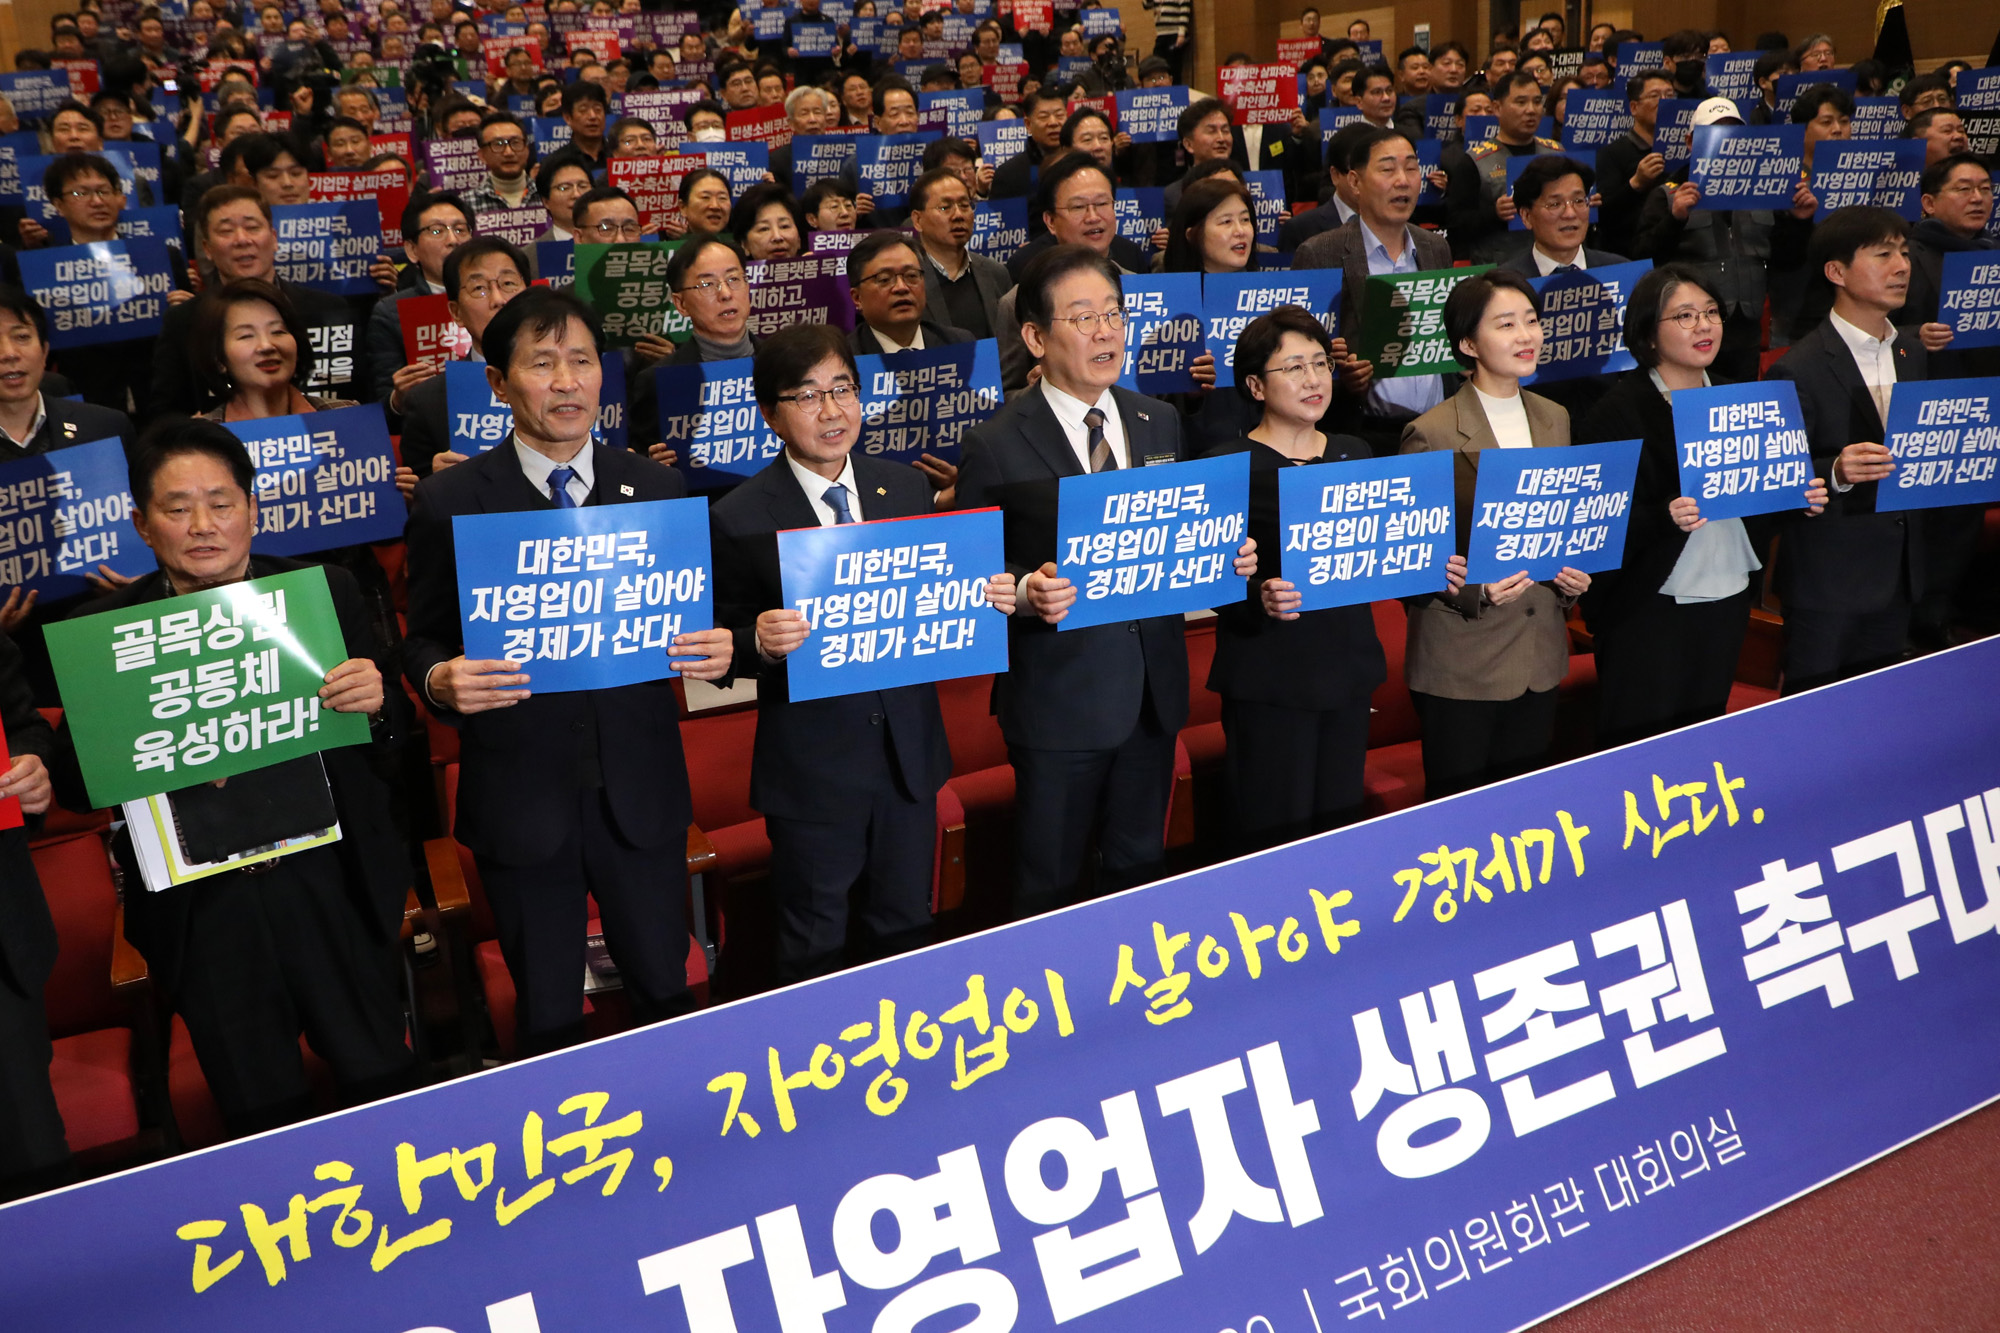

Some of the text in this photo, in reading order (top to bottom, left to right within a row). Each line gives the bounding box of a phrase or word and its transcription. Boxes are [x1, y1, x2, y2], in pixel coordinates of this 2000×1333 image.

[1220, 67, 1260, 80] 대기업만
[1120, 108, 1157, 121] 자영업이
[1132, 94, 1173, 107] 대한민국,
[1236, 96, 1279, 108] 할인행사
[1584, 99, 1625, 114] 대한민국,
[1855, 105, 1899, 120] 대한민국,
[1129, 121, 1157, 134] 경제가
[1565, 114, 1609, 128] 자영업이
[1573, 129, 1606, 144] 경제가
[984, 141, 1025, 156] 자영업이
[1719, 137, 1783, 157] 대한민국,
[1837, 151, 1897, 170] 대한민국,
[612, 159, 660, 176] 대기업만
[795, 159, 840, 175] 자영업이
[861, 163, 909, 180] 자영업이
[1693, 157, 1801, 177] 자영업이 살아야
[1813, 169, 1920, 190] 자영업이 살아야
[872, 180, 909, 197] 경제가
[1704, 176, 1788, 196] 경제가 산다!
[1824, 187, 1904, 210] 경제가 산다!
[279, 215, 352, 239] 대한민국,
[475, 208, 548, 231] 온라인플랫폼
[1122, 217, 1163, 234] 살아야
[329, 234, 380, 258] 살아야
[987, 227, 1027, 247] 살아야
[55, 253, 138, 282] 대한민국,
[330, 259, 367, 279] 산다!
[745, 256, 849, 284] 라인플랫폼 독점
[33, 271, 171, 302] 자영업이 살아야
[750, 287, 807, 310] 제하고,
[1390, 276, 1475, 307] 골목상
[1543, 281, 1624, 312] 대한민국,
[54, 298, 160, 331] 경제가 산다!
[1124, 291, 1169, 318] 민국,
[1140, 318, 1200, 346] 살아야
[1397, 308, 1448, 337] 공동
[1538, 310, 1592, 340] 영업이
[1138, 348, 1185, 376] 산다!
[1537, 338, 1593, 365] 경제가
[872, 363, 964, 399] 대한민국,
[855, 385, 999, 430] 영업이 살아야
[1709, 399, 1786, 433] 대한민국,
[1917, 397, 1991, 427] 대한민국,
[666, 406, 757, 441] 자영업이
[864, 422, 934, 455] 경제가
[689, 436, 756, 468] 경제가
[1683, 427, 1810, 469] 자영업이 살아야
[1889, 425, 2000, 459] 자영업이 살아
[255, 455, 391, 504] 업이 살아야
[1516, 464, 1603, 497] 대한민국,
[1702, 459, 1806, 500] 경제가 산다!
[1898, 456, 1997, 489] 경제가 산다!
[1103, 482, 1211, 526] 대한민국,
[1320, 476, 1417, 517] 대한민국,
[1478, 491, 1629, 530] 자영업이 살아야
[50, 492, 133, 541] 살아야
[252, 493, 376, 539] 제가 산다!
[1286, 505, 1451, 554] 자영업이 살아야
[57, 532, 119, 573] 산다!
[516, 530, 656, 576] 대한민국,
[1062, 512, 1244, 568] 자영업이 살아야
[1495, 525, 1607, 562] 경제가 산다!
[833, 541, 954, 586] 대한민국,
[1085, 552, 1224, 601] 경제가 산다!
[1308, 543, 1432, 586] 경제가 산다!
[468, 566, 705, 624] 자영업이 살아야
[795, 585, 906, 632] 자영업이
[111, 589, 290, 674] 골목상권
[502, 612, 682, 664] 경제가 산다!
[820, 617, 976, 668] 경제가 산다!
[148, 647, 280, 720] 공동체
[132, 696, 320, 774] 육성하라!
[176, 761, 1766, 1293] 대한민국, 자영업이 살아야 경제가 산다.
[637, 1041, 1325, 1333] 자영업자
[1350, 898, 1728, 1180] 생존권
[1333, 1108, 1748, 1325] 국회의원회관 대회의실
